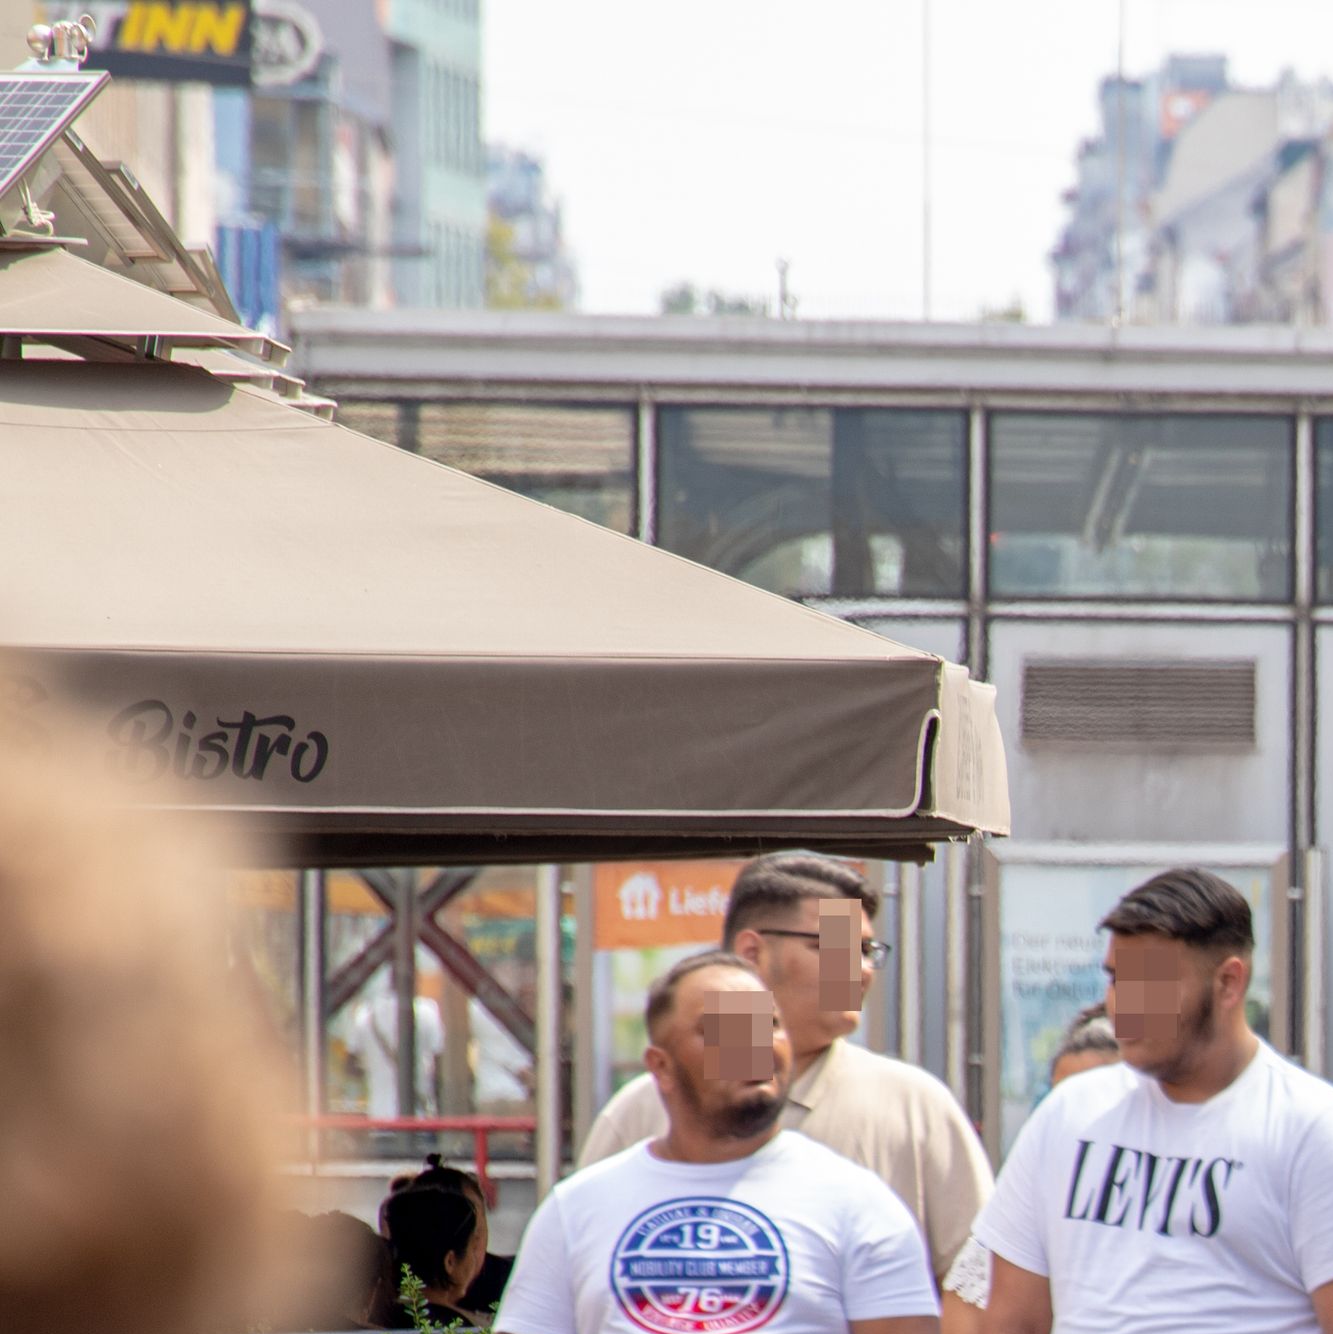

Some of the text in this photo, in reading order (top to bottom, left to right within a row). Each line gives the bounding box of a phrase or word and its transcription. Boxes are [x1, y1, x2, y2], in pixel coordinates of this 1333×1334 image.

[104, 698, 329, 785] Bistro
[1063, 1140, 1235, 1239] LEVI'S
[678, 1223, 721, 1250] 19
[718, 1260, 769, 1277] MEMBER
[677, 1287, 723, 1313] 76
